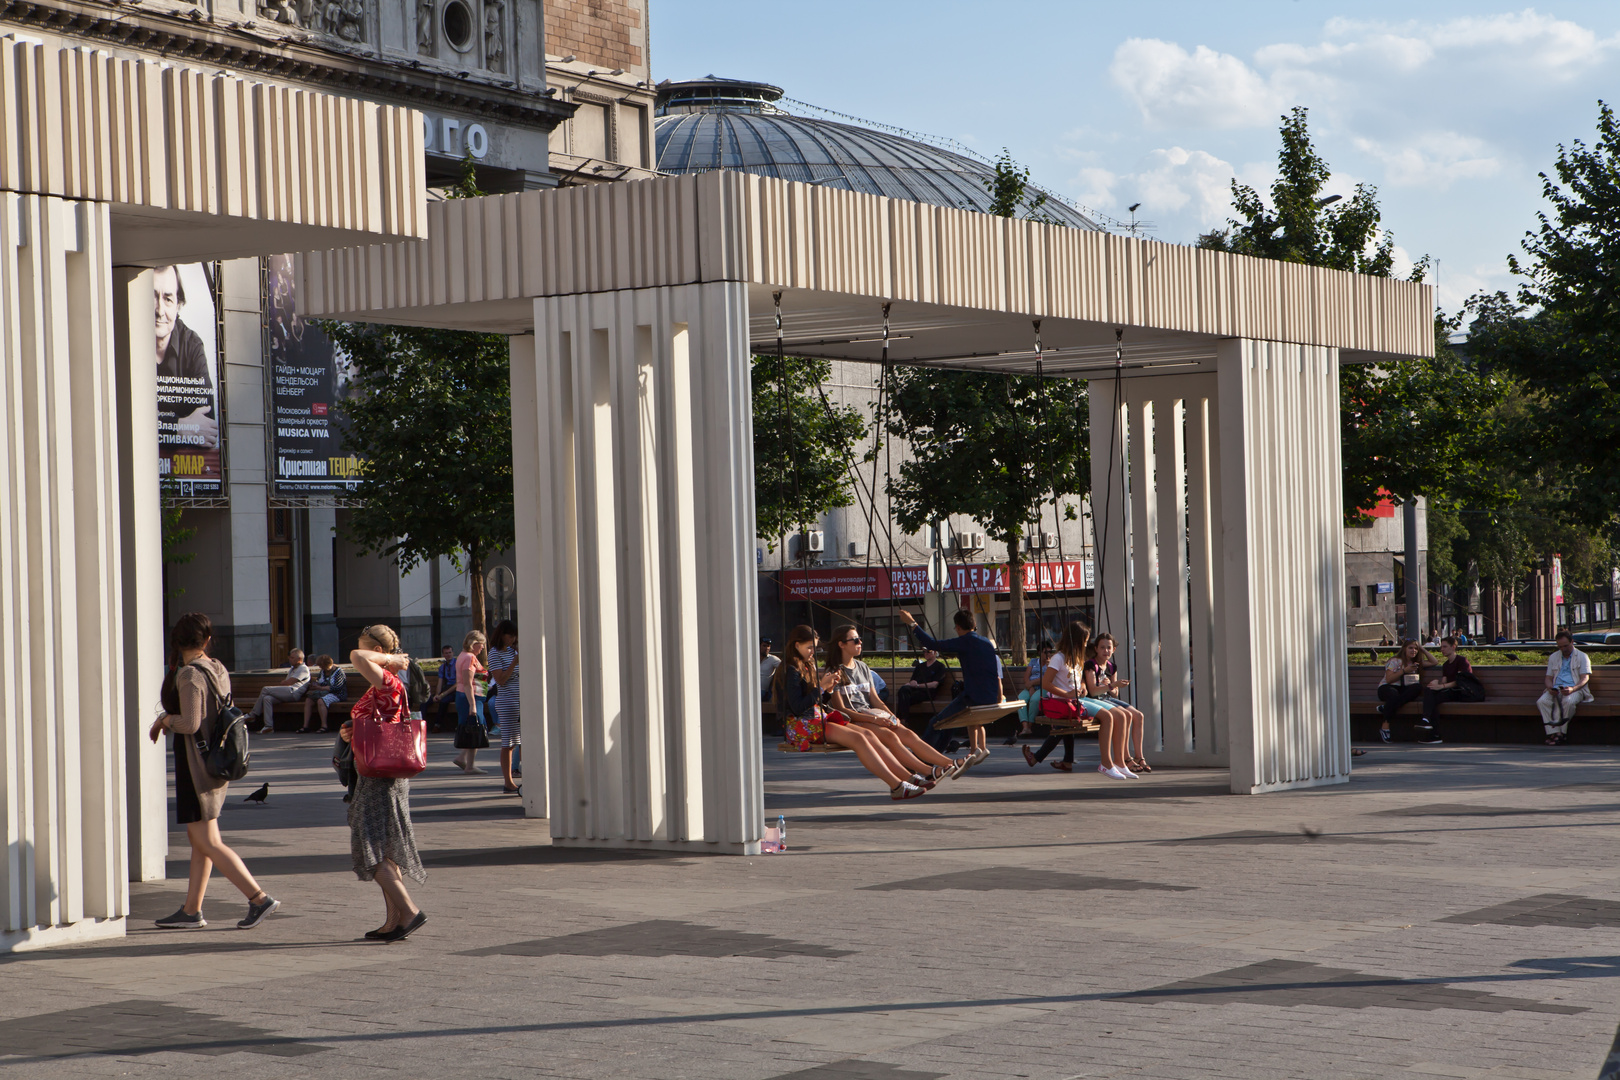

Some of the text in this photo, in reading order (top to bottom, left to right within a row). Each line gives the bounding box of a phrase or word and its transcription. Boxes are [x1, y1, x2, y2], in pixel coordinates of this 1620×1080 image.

[276, 364, 326, 376] ГАЙДН МОЦАРТ
[276, 376, 319, 386] МЕНДЕЛЬСОН
[276, 386, 305, 396] ШЁНБЕРГ
[183, 396, 208, 405] РОССИИ
[277, 406, 311, 416] Московский
[277, 417, 329, 428] камерный оркестр
[278, 428, 329, 438] MUSICA VIVA
[158, 433, 205, 445] СПИВАКОВ
[173, 454, 204, 474] ЭМАР
[278, 456, 328, 479] Кристиан
